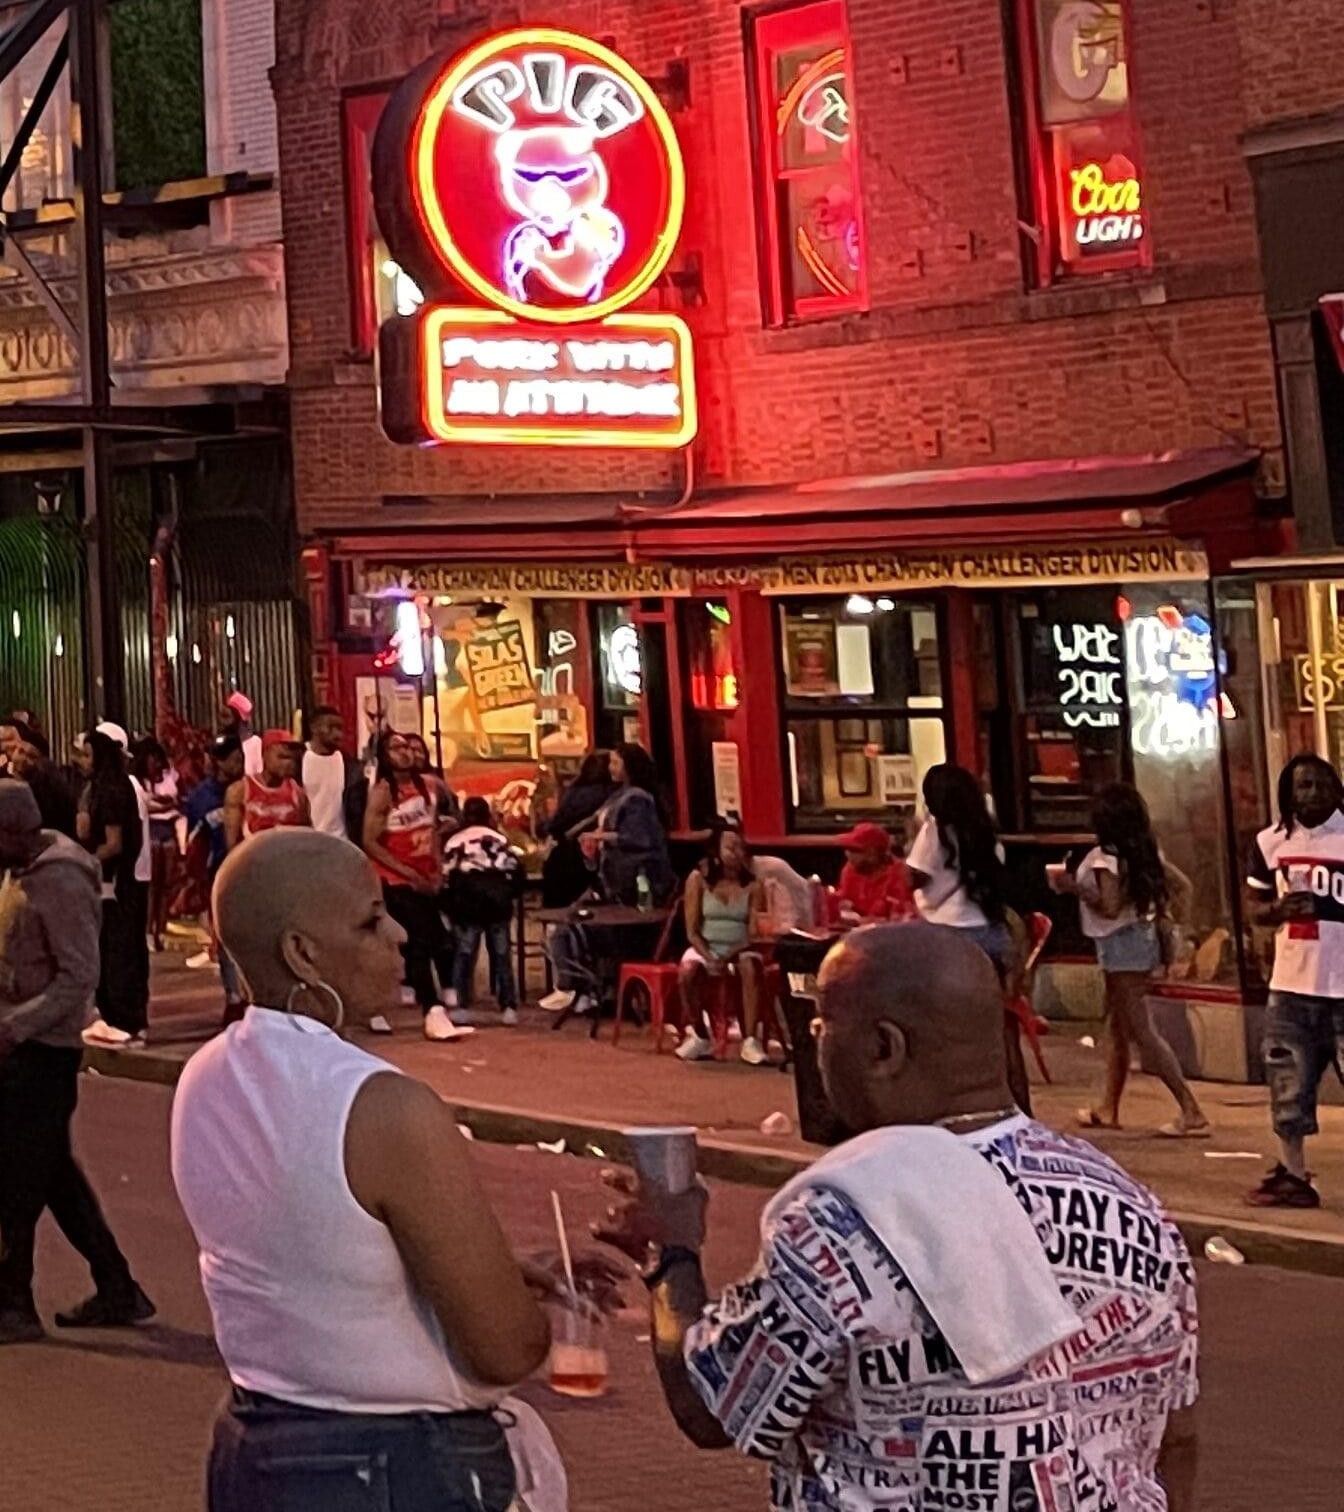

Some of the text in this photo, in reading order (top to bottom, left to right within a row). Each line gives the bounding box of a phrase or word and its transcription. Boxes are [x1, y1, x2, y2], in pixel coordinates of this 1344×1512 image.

[451, 52, 646, 140] PIG
[960, 548, 1086, 580] CHALLENGER
[1087, 543, 1179, 575] DIVISION
[1117, 1199, 1163, 1254] FLY
[857, 1338, 912, 1385] FLY
[924, 1429, 1006, 1460] ALL
[922, 1462, 1000, 1490] THE
[923, 1487, 999, 1511] MOST
